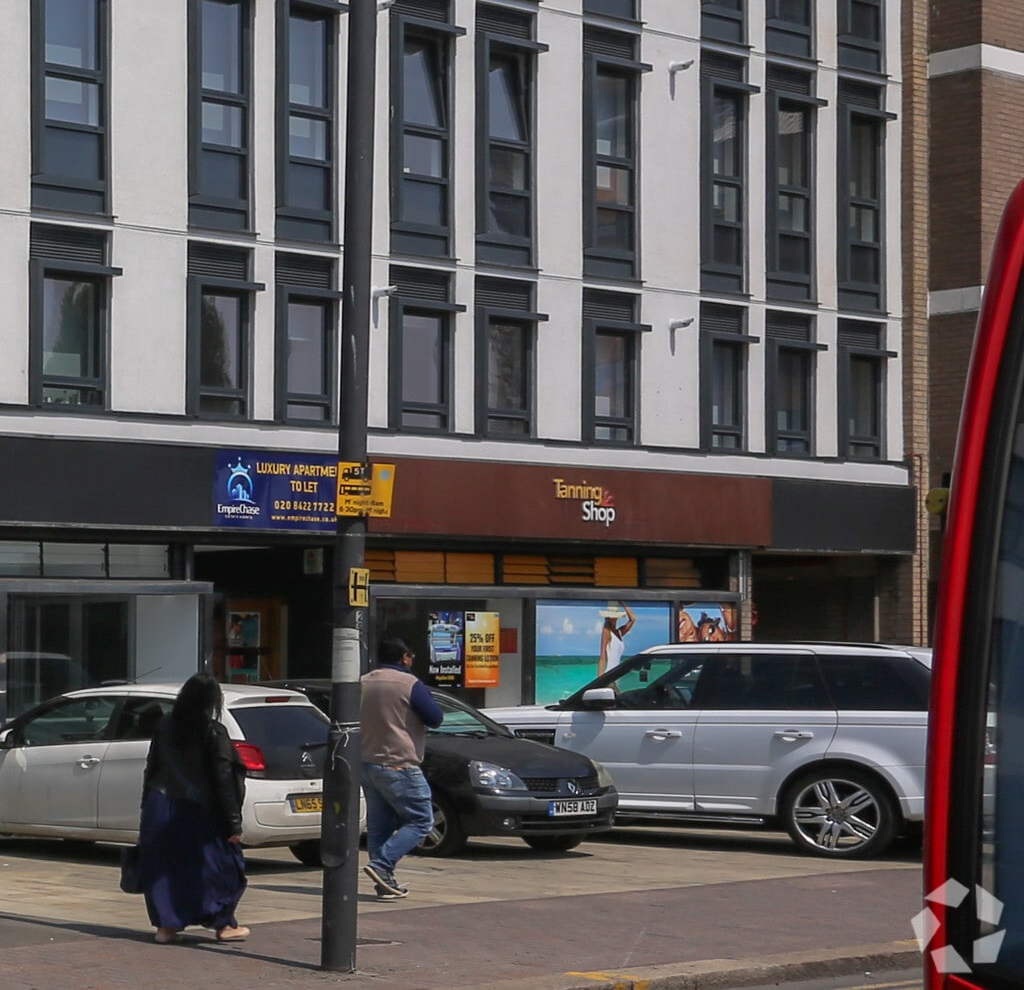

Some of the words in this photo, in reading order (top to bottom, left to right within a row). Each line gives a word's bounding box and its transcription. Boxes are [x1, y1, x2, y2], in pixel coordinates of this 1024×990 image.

[256, 461, 291, 475] LUXURY
[293, 464, 338, 478] APARTME
[290, 480, 302, 492] TO
[303, 481, 318, 493] LET
[553, 478, 603, 506] Tanning
[217, 503, 260, 515] EmpireChase
[274, 500, 291, 510] 020
[293, 500, 312, 511] 8422
[313, 501, 335, 512] 7722
[582, 500, 616, 527] Shop
[470, 633, 484, 643] 25%
[485, 633, 495, 643] OFF
